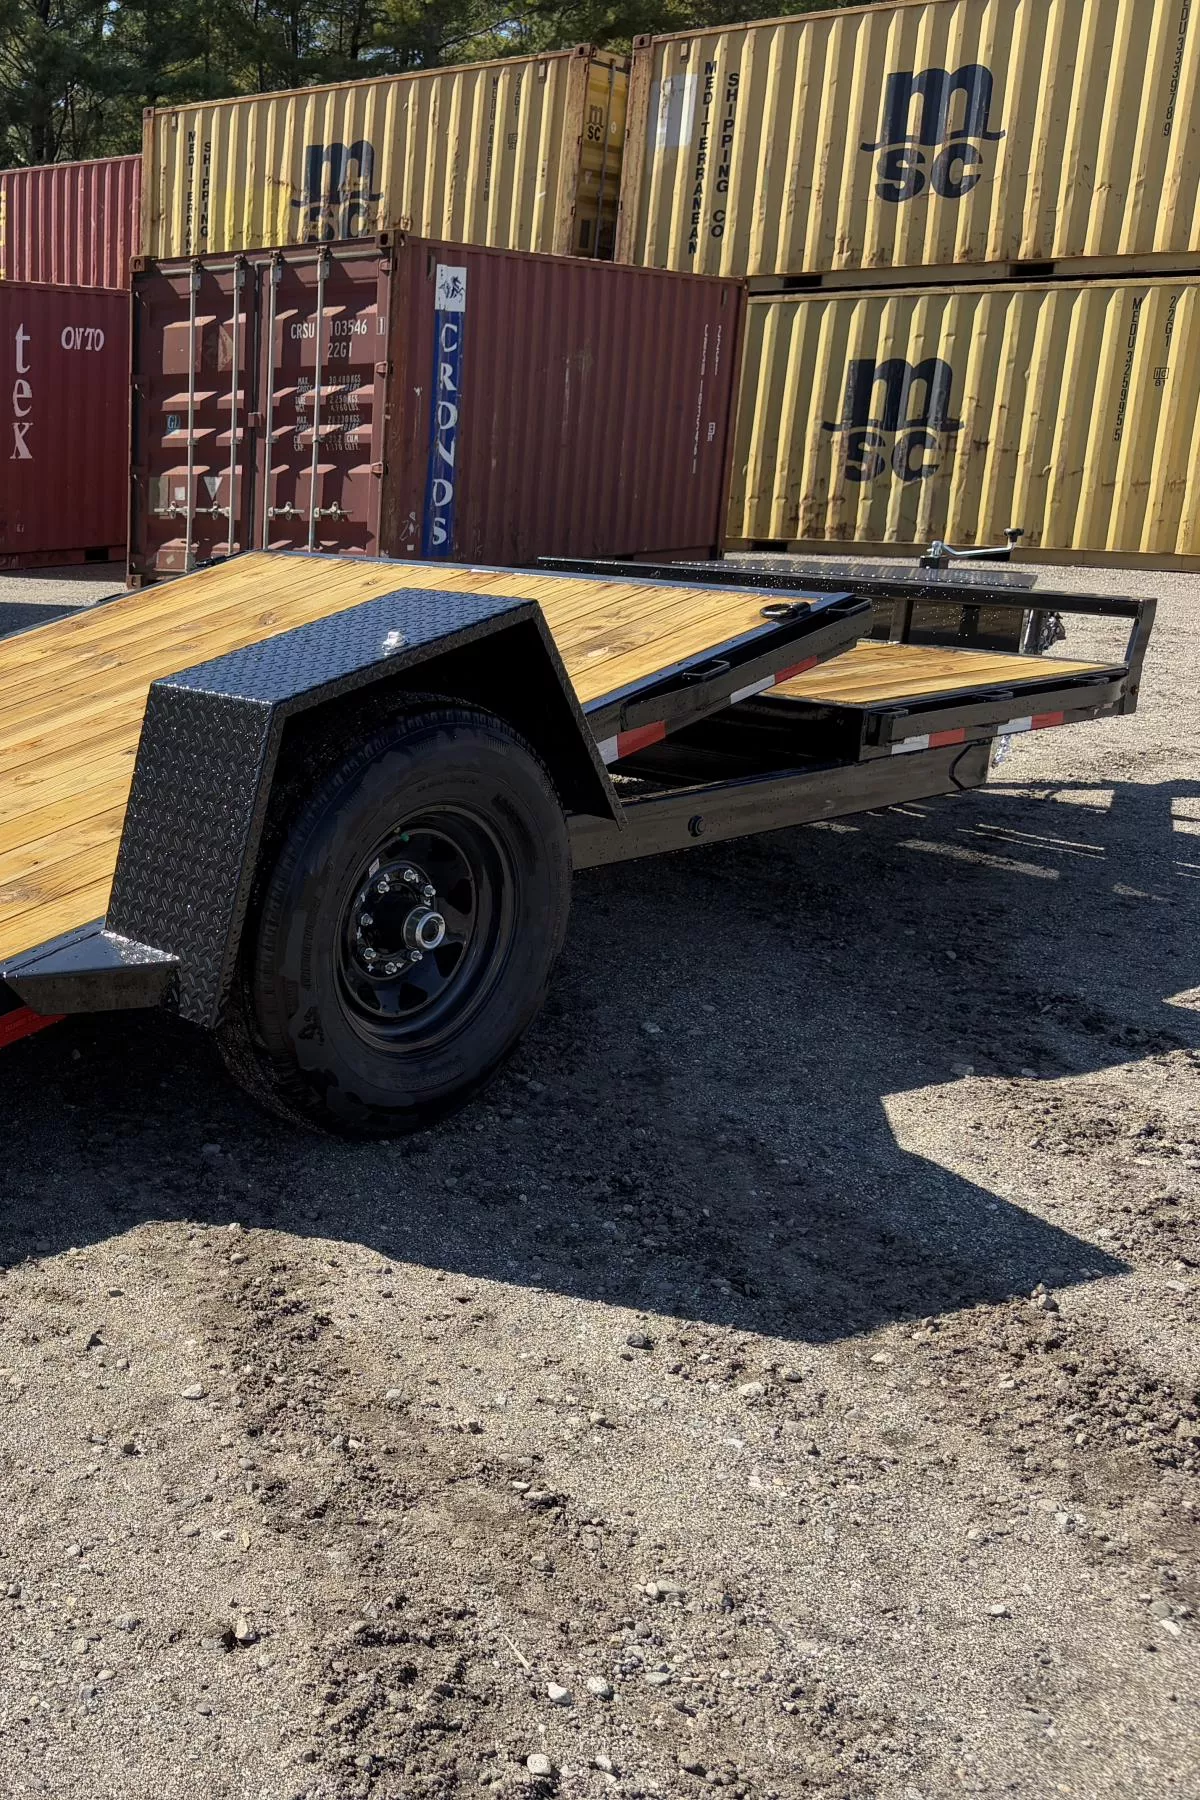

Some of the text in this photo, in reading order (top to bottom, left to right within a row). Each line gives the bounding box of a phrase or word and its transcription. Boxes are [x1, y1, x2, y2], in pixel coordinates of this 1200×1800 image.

[201, 142, 211, 238] SHIPPING
[688, 60, 717, 255] MEDITERRANEAN
[711, 73, 739, 239] SHIPPING CO
[290, 322, 315, 339] CRSU
[330, 318, 367, 337] 103546
[328, 341, 352, 358] 22G1
[9, 323, 33, 459] tex
